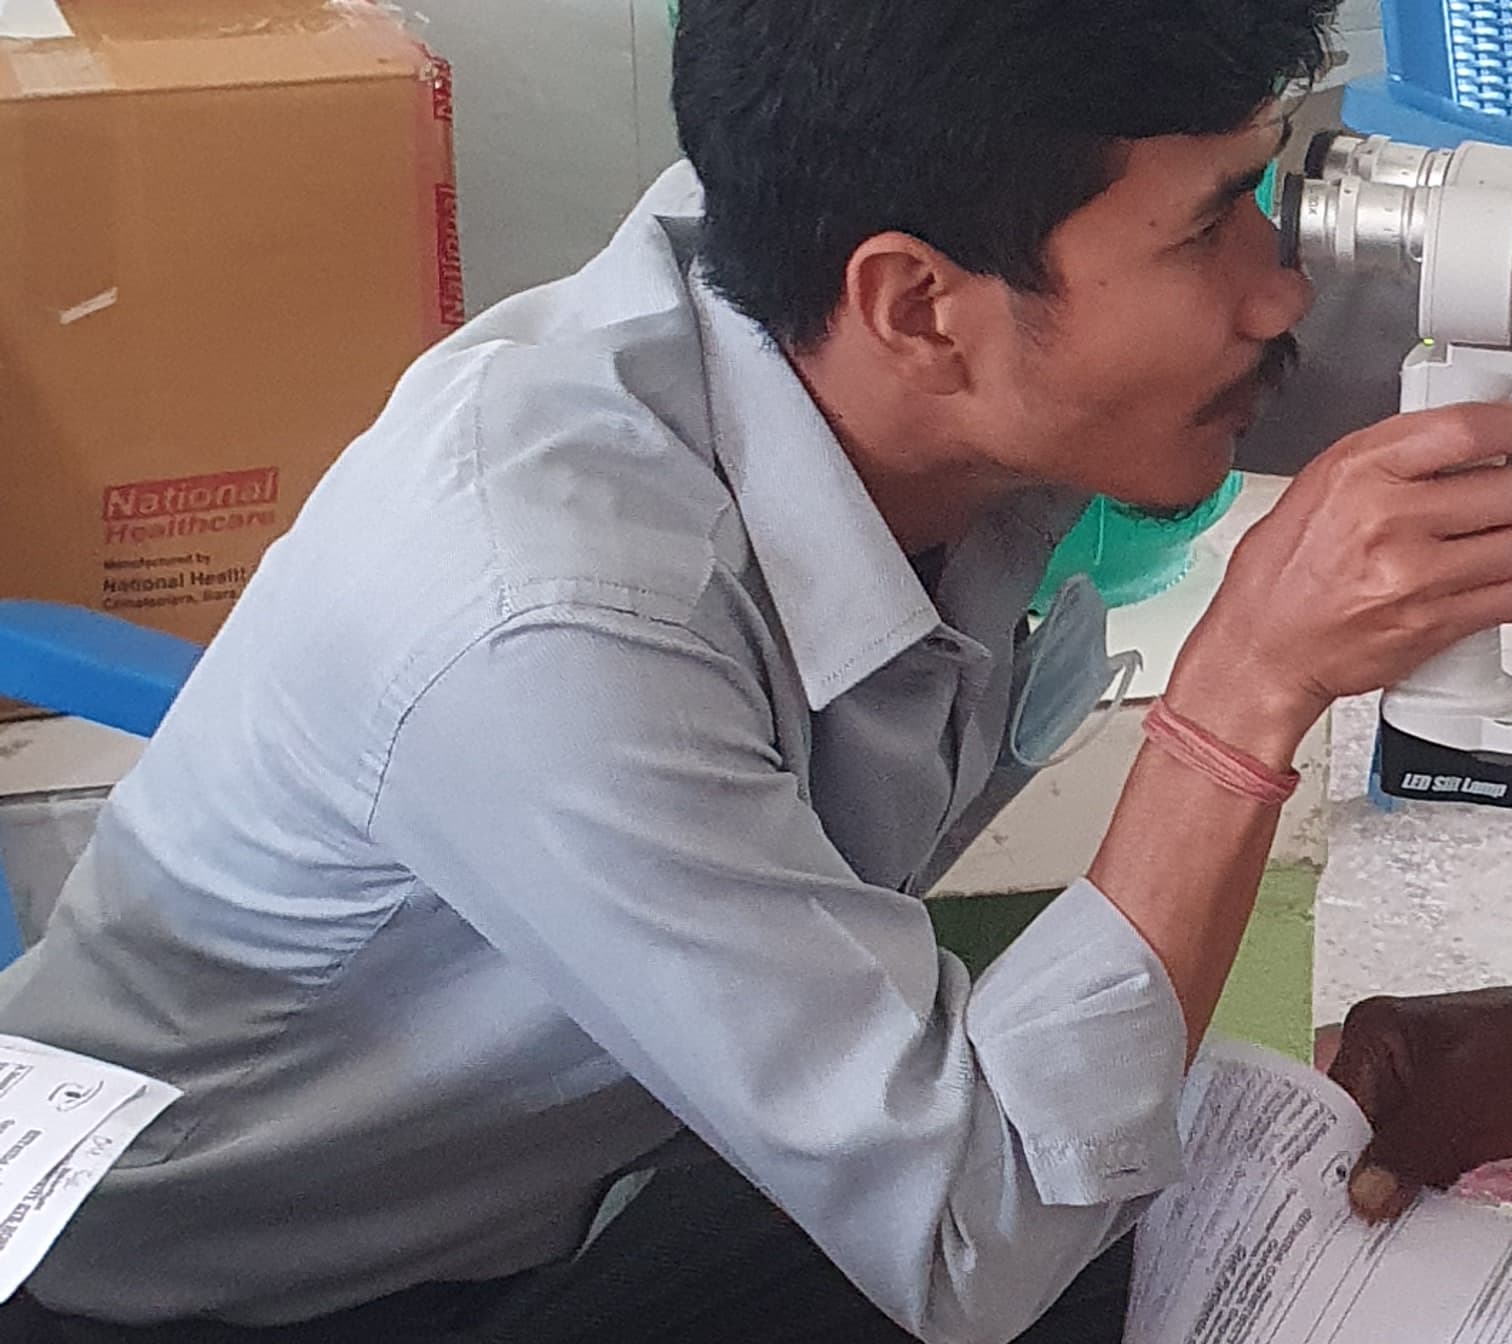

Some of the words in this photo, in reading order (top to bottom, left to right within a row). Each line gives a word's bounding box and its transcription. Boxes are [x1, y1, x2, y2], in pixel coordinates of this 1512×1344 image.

[107, 471, 274, 517] National
[106, 511, 275, 544] Healthcare
[103, 573, 185, 593] National
[1401, 773, 1431, 792] LED
